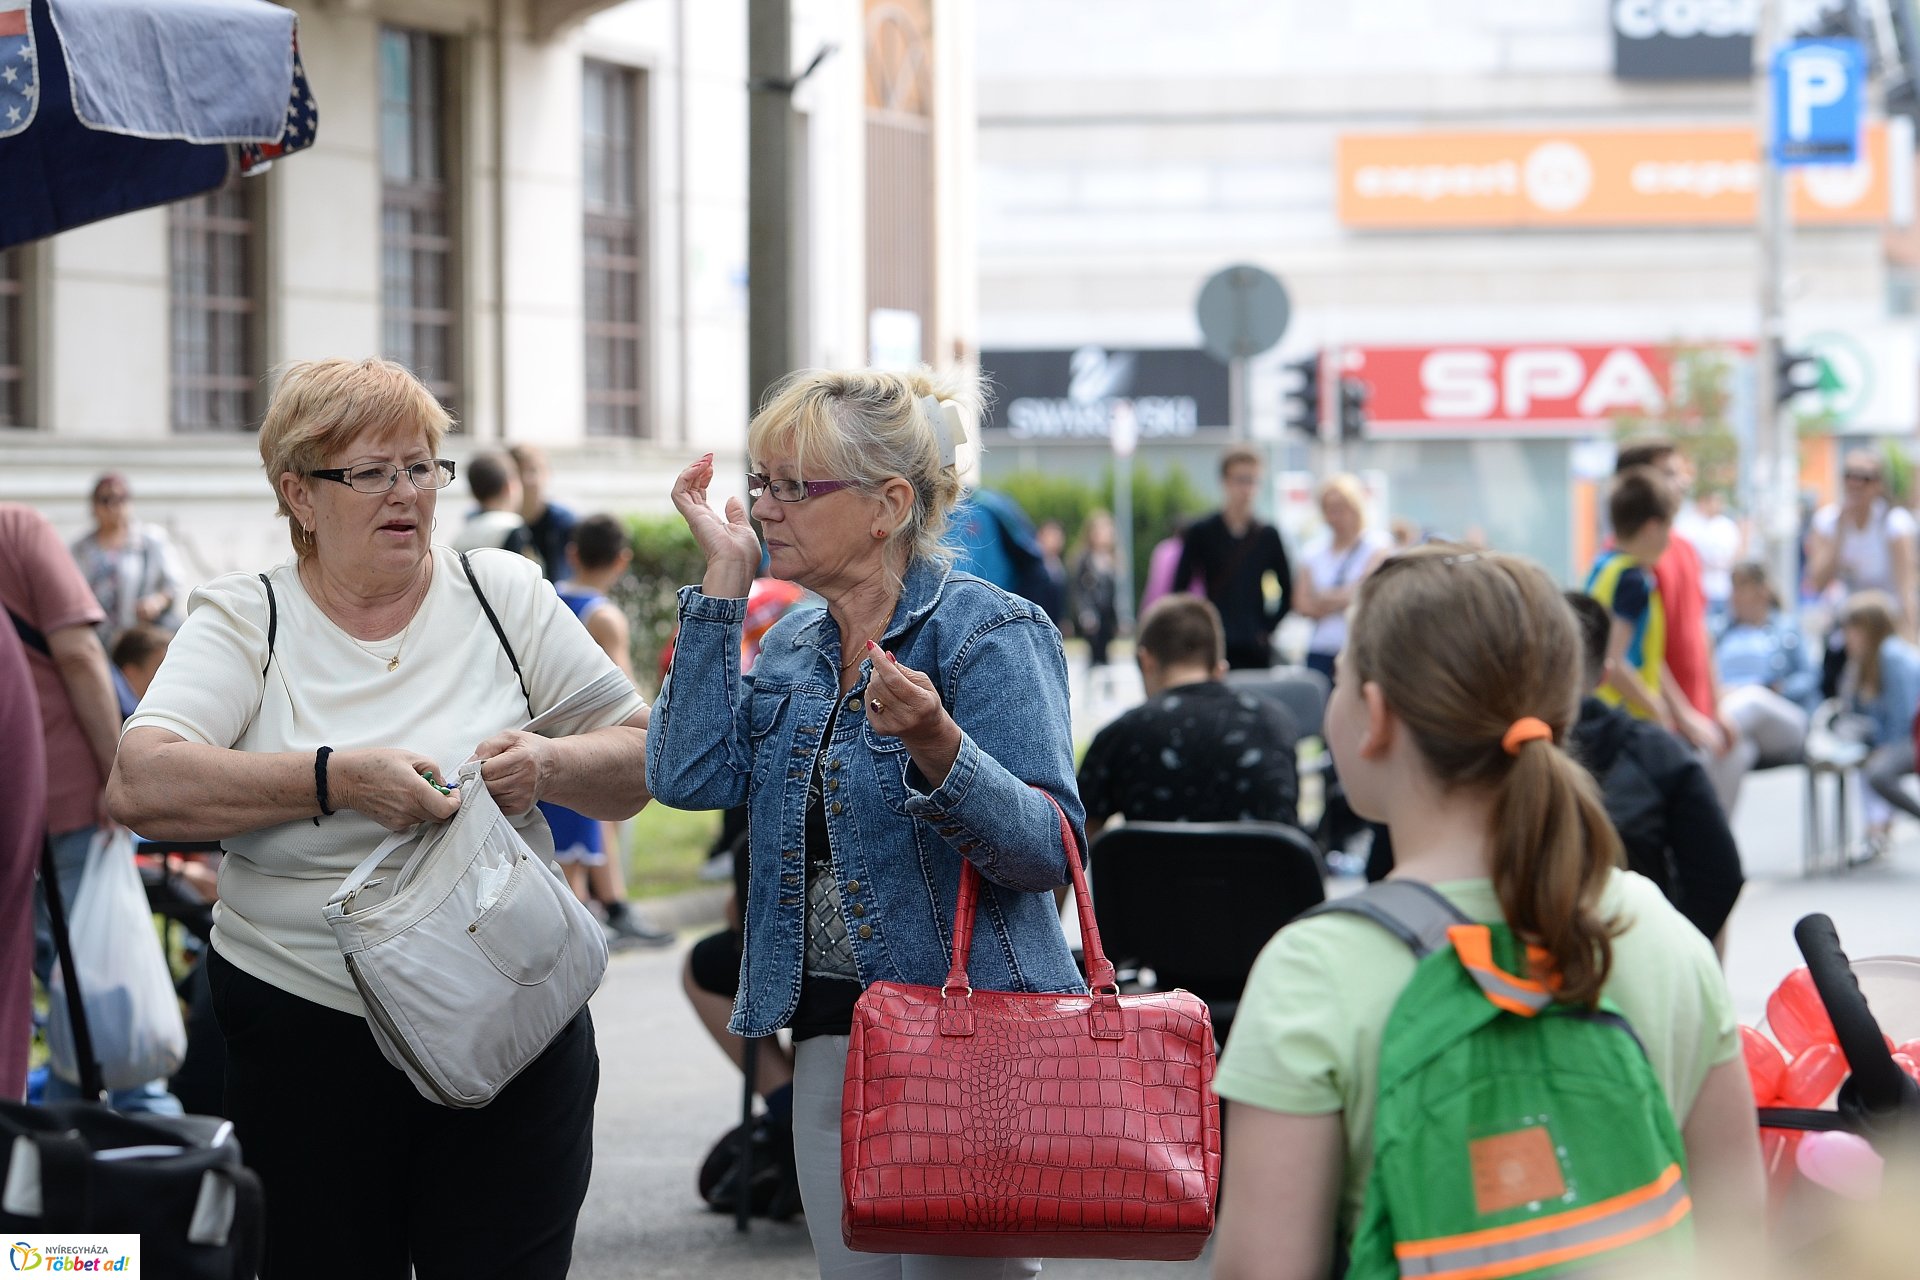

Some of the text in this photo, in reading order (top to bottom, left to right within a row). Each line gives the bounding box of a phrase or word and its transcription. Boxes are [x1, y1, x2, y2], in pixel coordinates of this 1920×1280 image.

[1787, 56, 1848, 142] P
[1354, 159, 1759, 203] expert expe
[1007, 396, 1198, 439] SWARSKI
